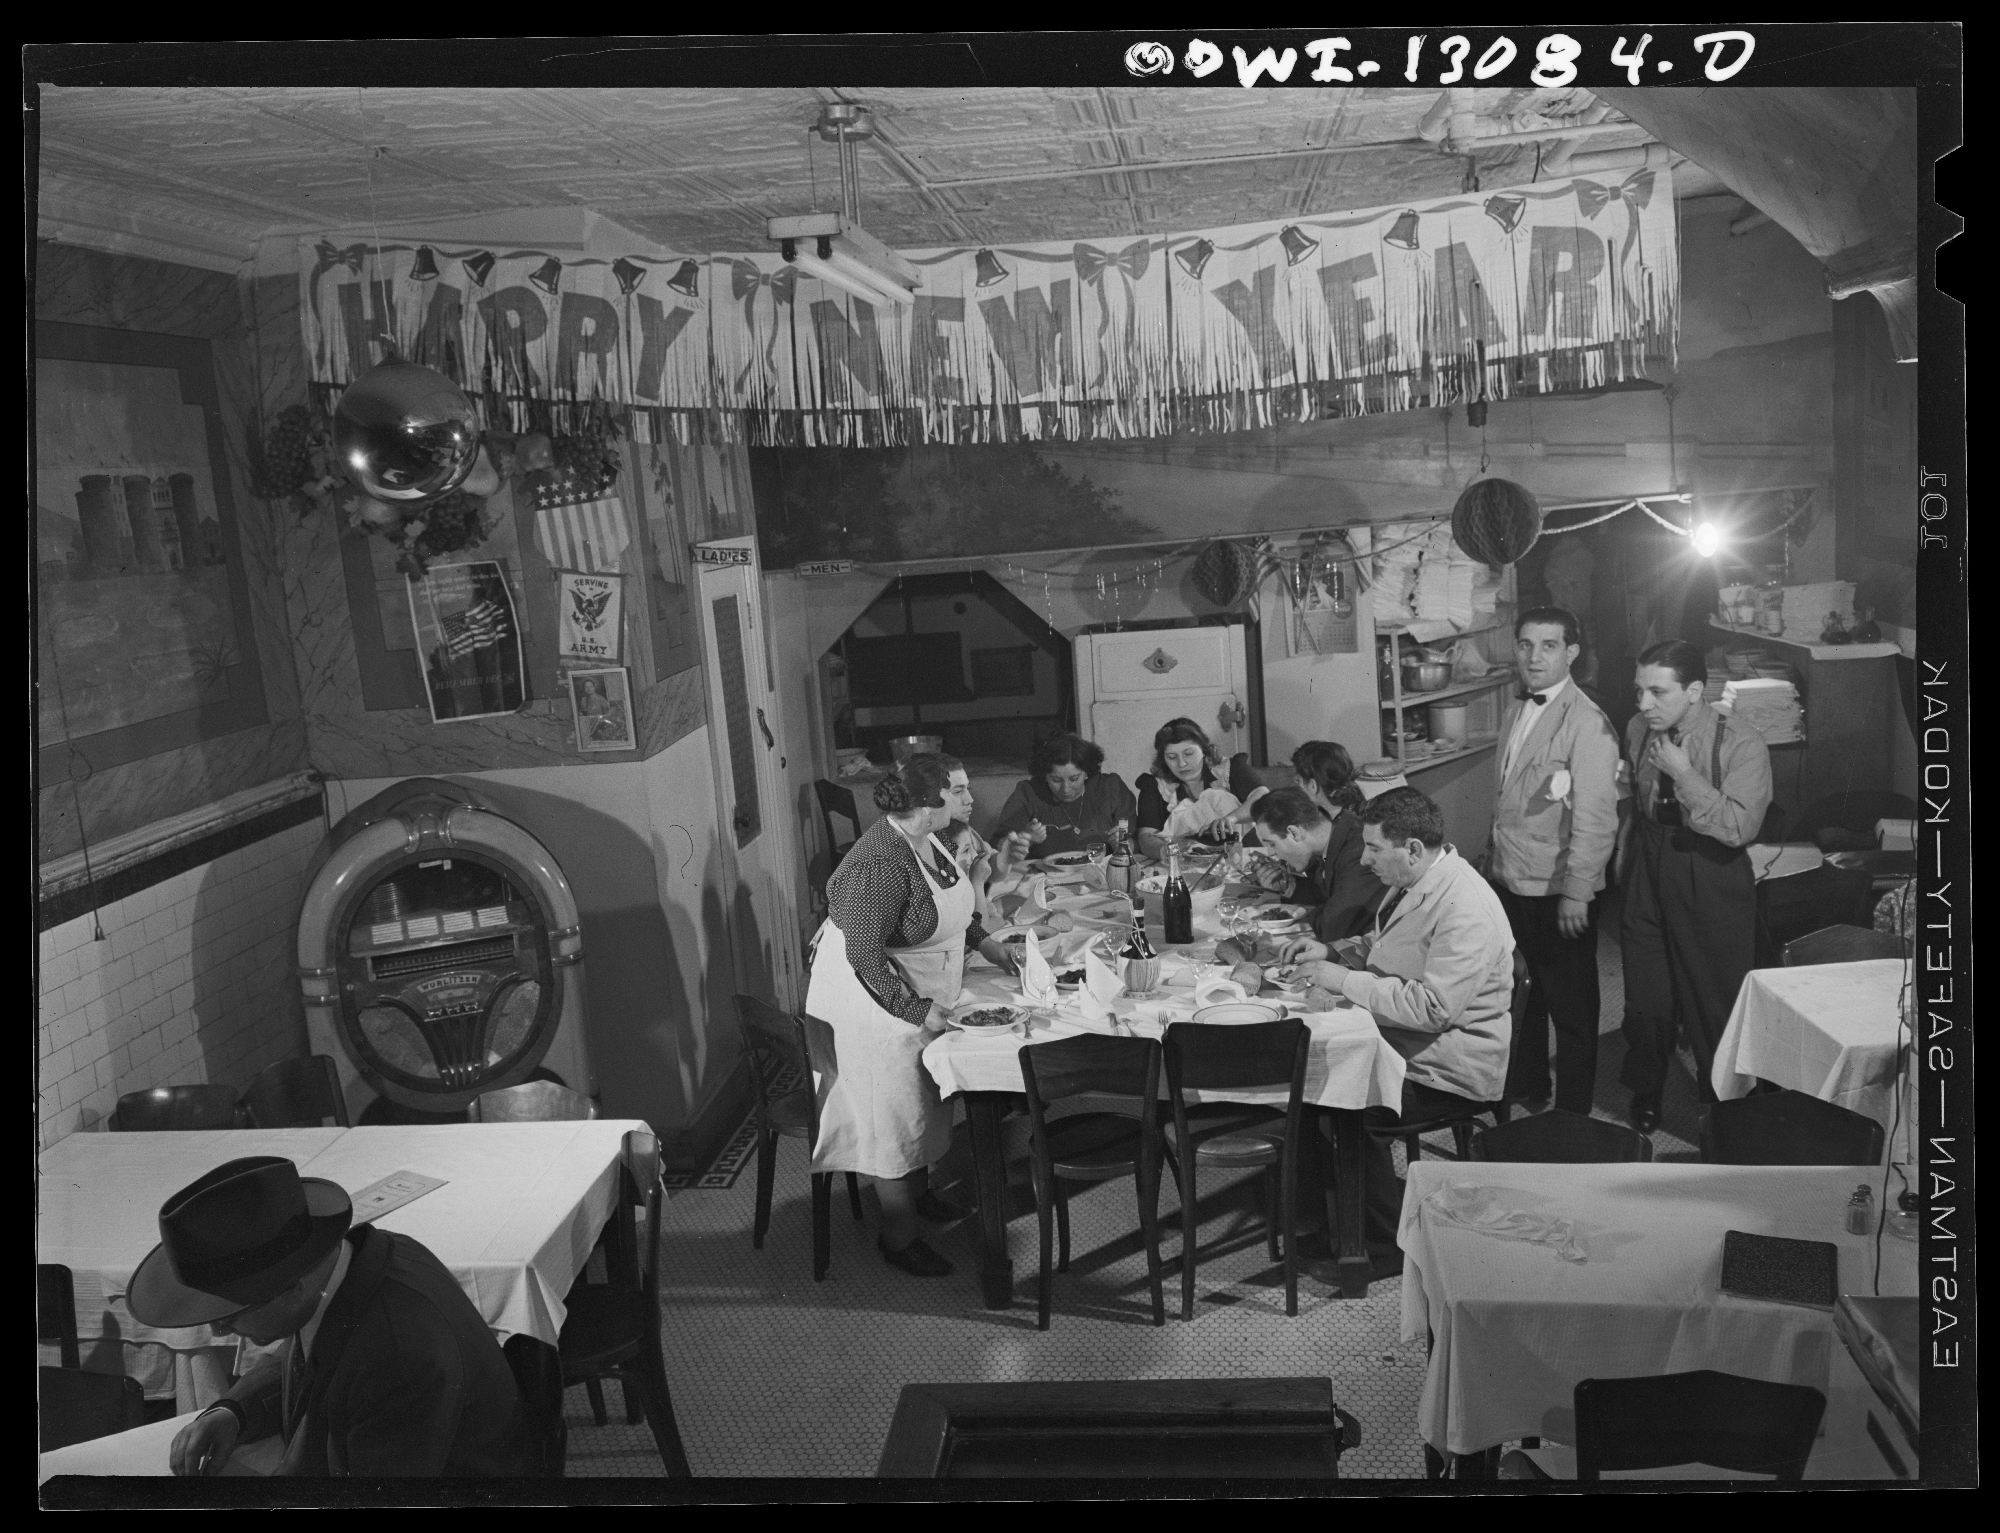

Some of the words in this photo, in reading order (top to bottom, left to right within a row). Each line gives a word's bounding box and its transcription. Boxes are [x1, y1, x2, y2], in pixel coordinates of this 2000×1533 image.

[338, 280, 692, 403] HAPPY
[810, 278, 1074, 398] NEW
[1211, 225, 1606, 383] YEAR
[701, 549, 749, 563] LADIES
[574, 578, 609, 589] SERVING
[571, 643, 608, 655] ARMY
[421, 975, 478, 991] WURLITZER
